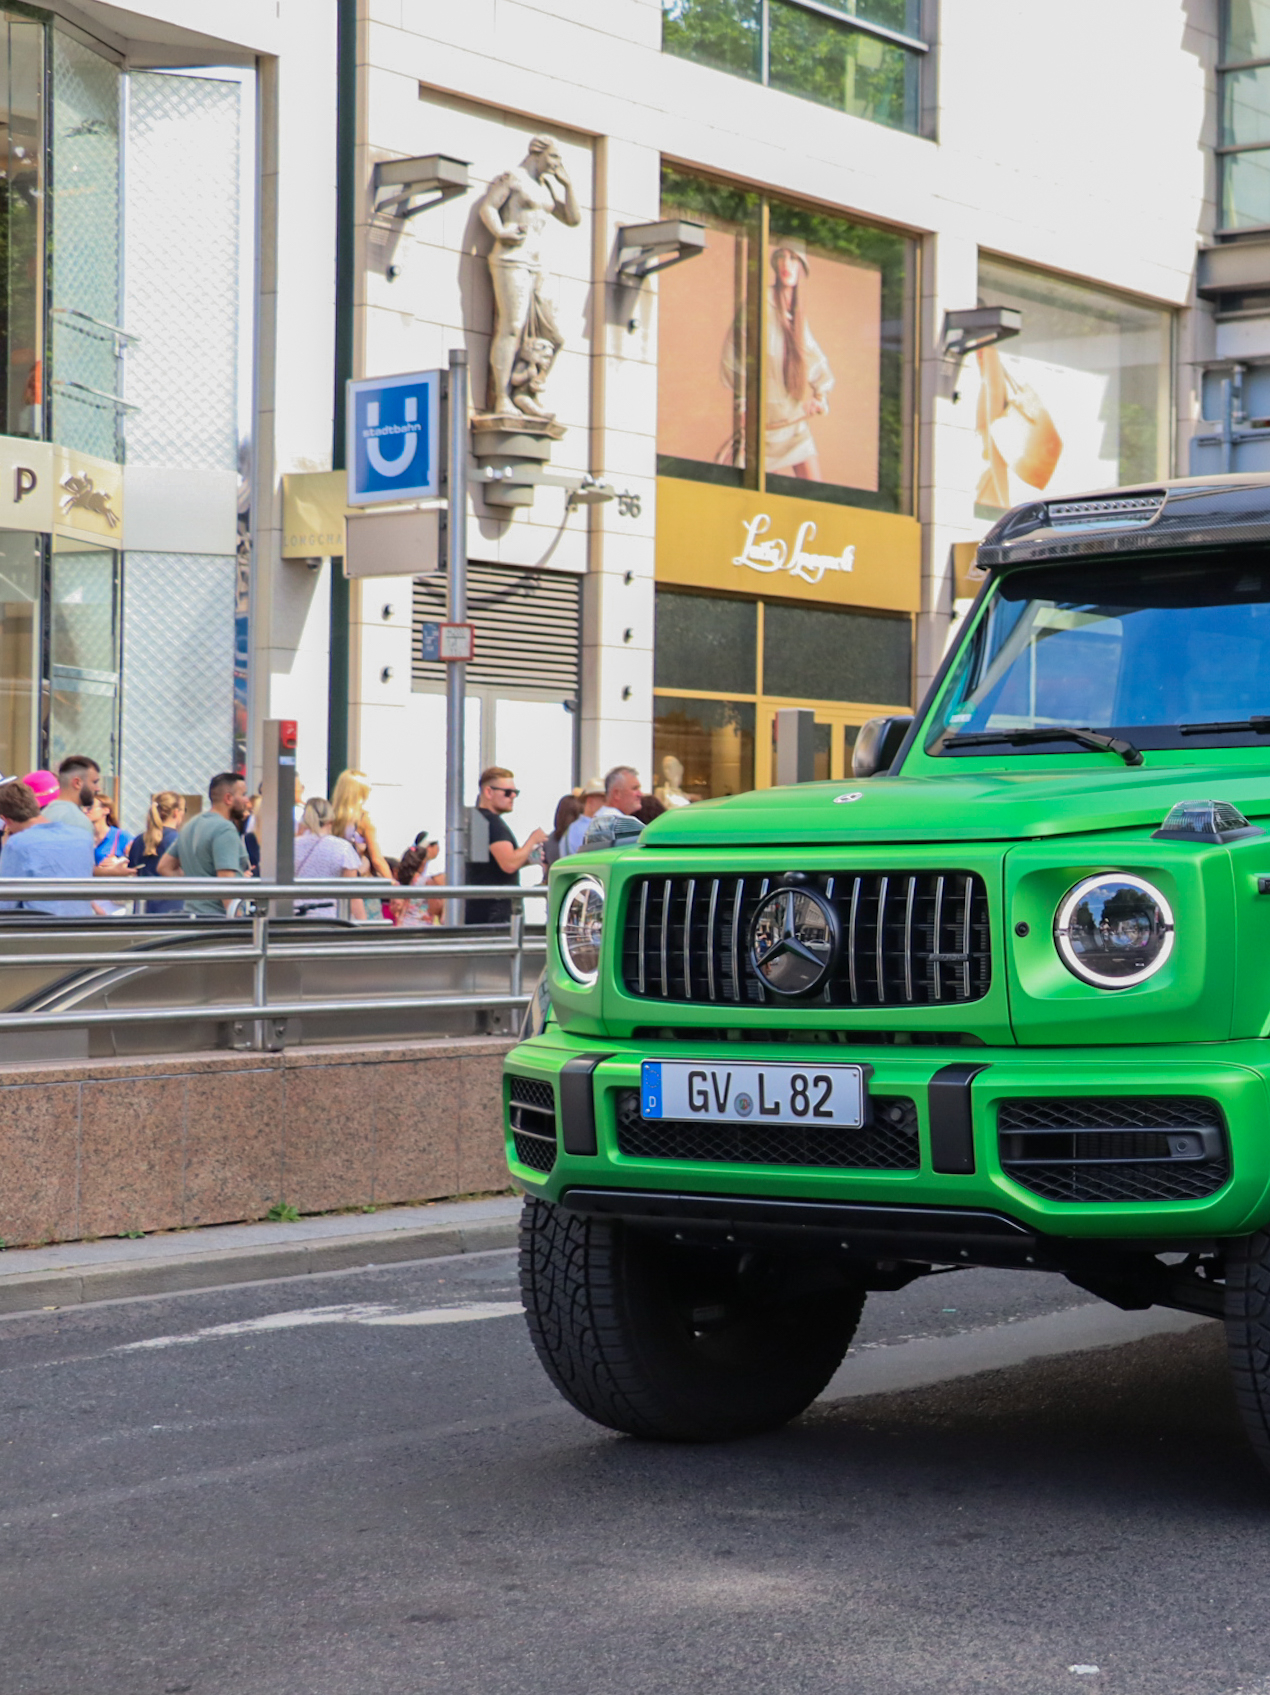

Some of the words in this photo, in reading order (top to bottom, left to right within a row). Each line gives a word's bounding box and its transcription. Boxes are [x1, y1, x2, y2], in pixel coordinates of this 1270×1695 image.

[362, 422, 422, 438] stadtbahn
[618, 494, 641, 518] 56
[688, 1070, 732, 1113] GV
[758, 1073, 780, 1115] L
[790, 1073, 834, 1118] 82
